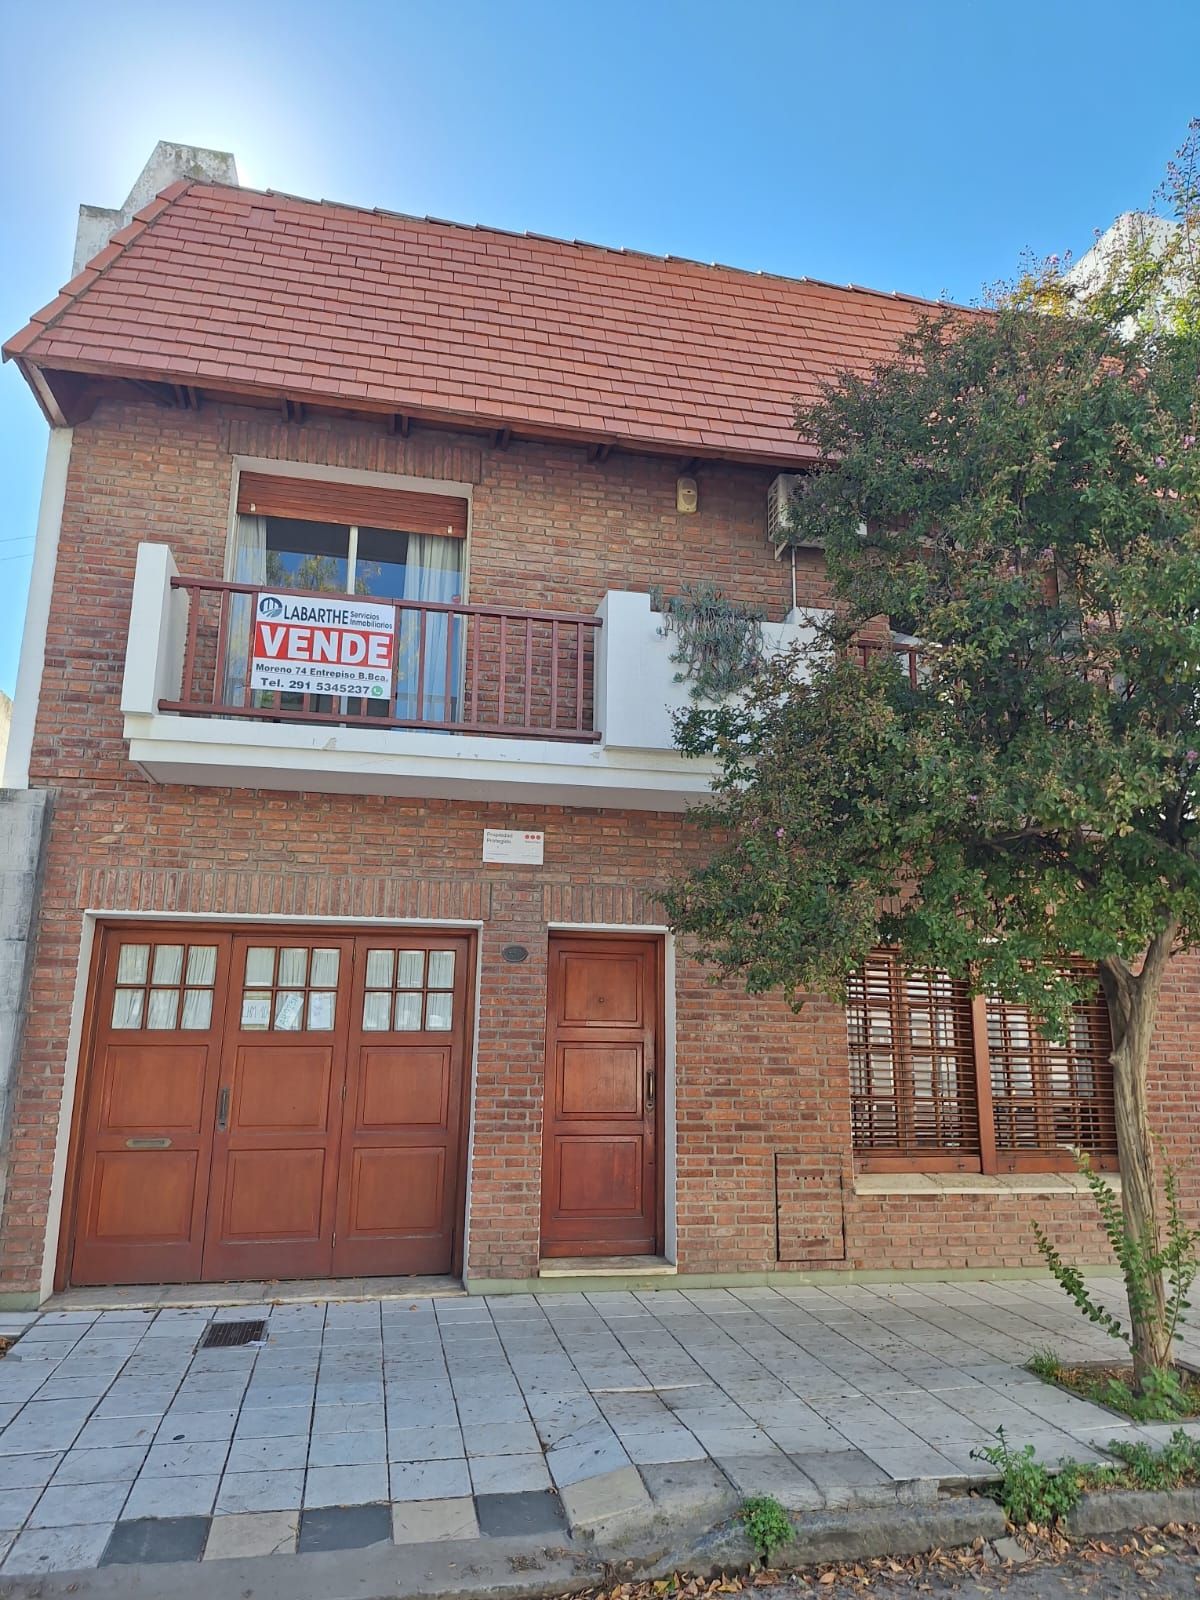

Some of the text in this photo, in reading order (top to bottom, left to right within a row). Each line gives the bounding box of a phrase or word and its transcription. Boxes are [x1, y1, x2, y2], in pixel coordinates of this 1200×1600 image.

[284, 604, 349, 625] LABARTHE
[350, 610, 380, 621] Servicios
[349, 619, 392, 630] Inmobiliarios
[260, 624, 390, 667] VENDE
[256, 663, 292, 674] Moreno
[295, 666, 307, 675] 74
[310, 667, 355, 680] Entrepiso
[261, 677, 370, 695] Tel. 291 5345237
